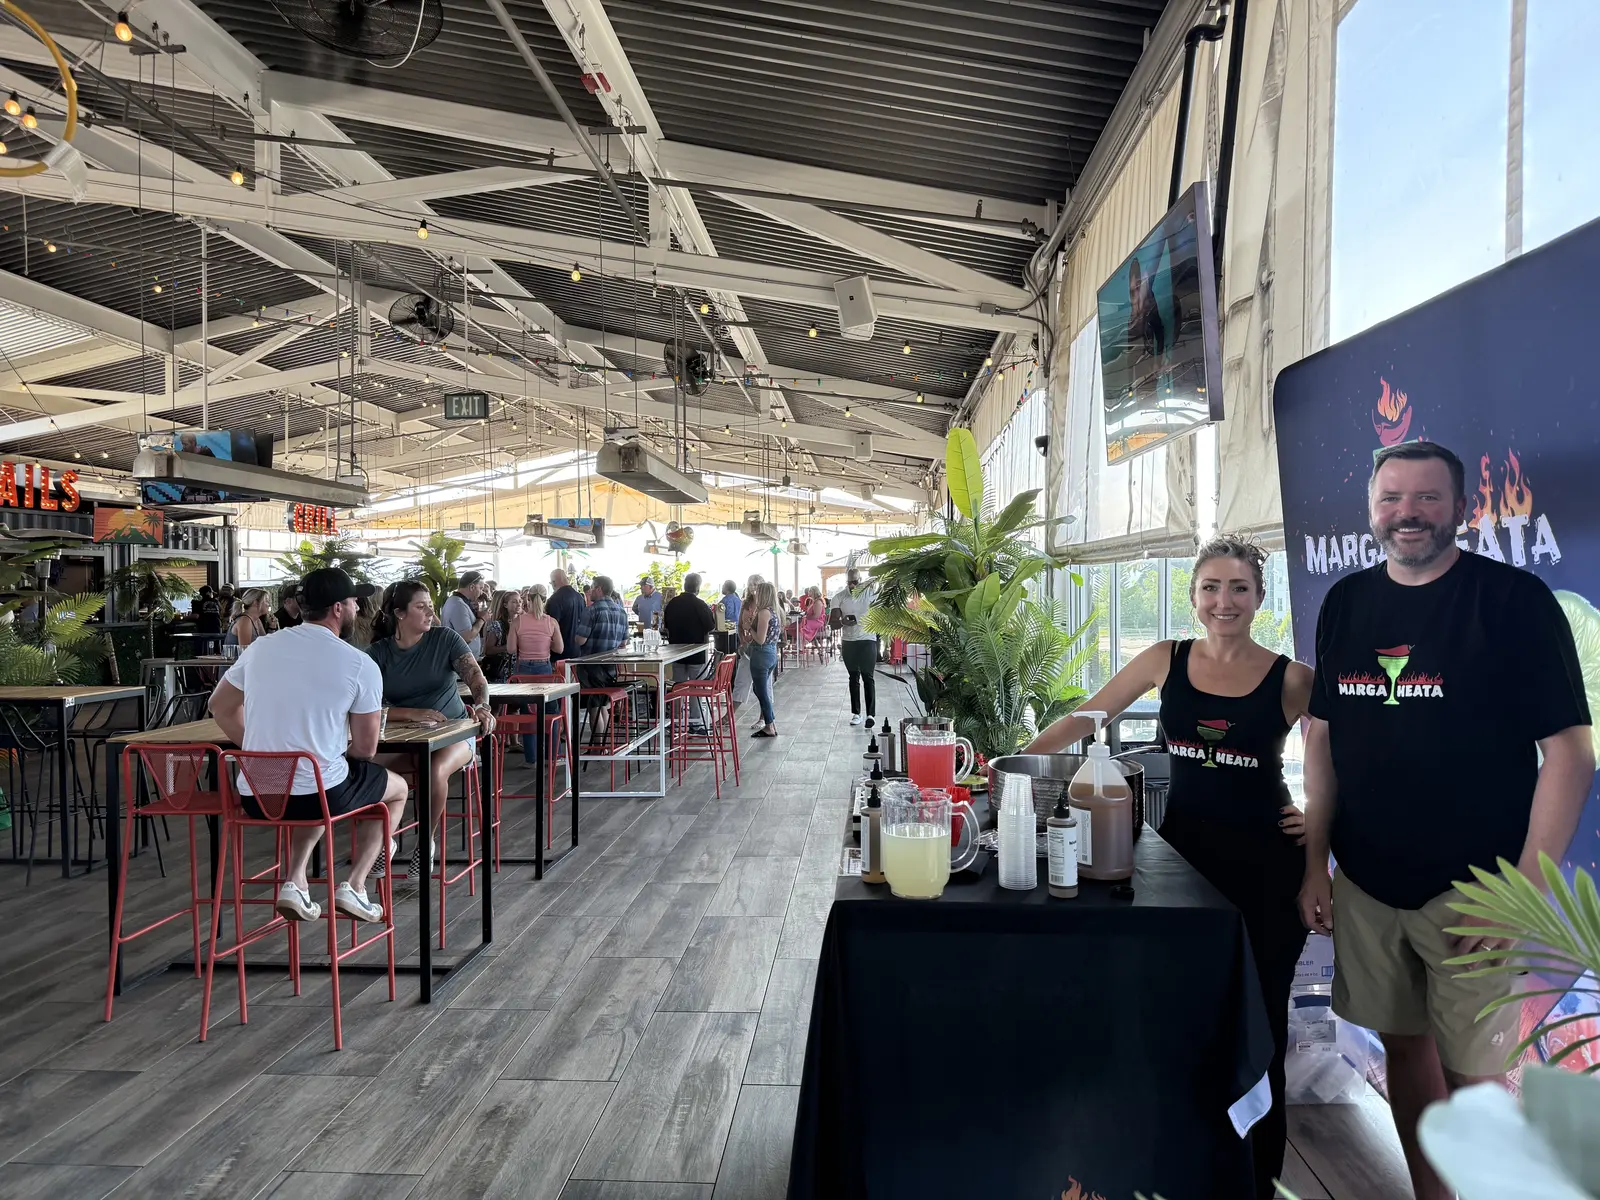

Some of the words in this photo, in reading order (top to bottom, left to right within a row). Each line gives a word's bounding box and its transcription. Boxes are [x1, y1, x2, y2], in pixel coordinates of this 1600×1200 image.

[452, 396, 480, 416] EXIT
[1338, 683, 1388, 697] MARGA
[1396, 684, 1444, 698] HEATA
[1215, 751, 1259, 768] HEATA
